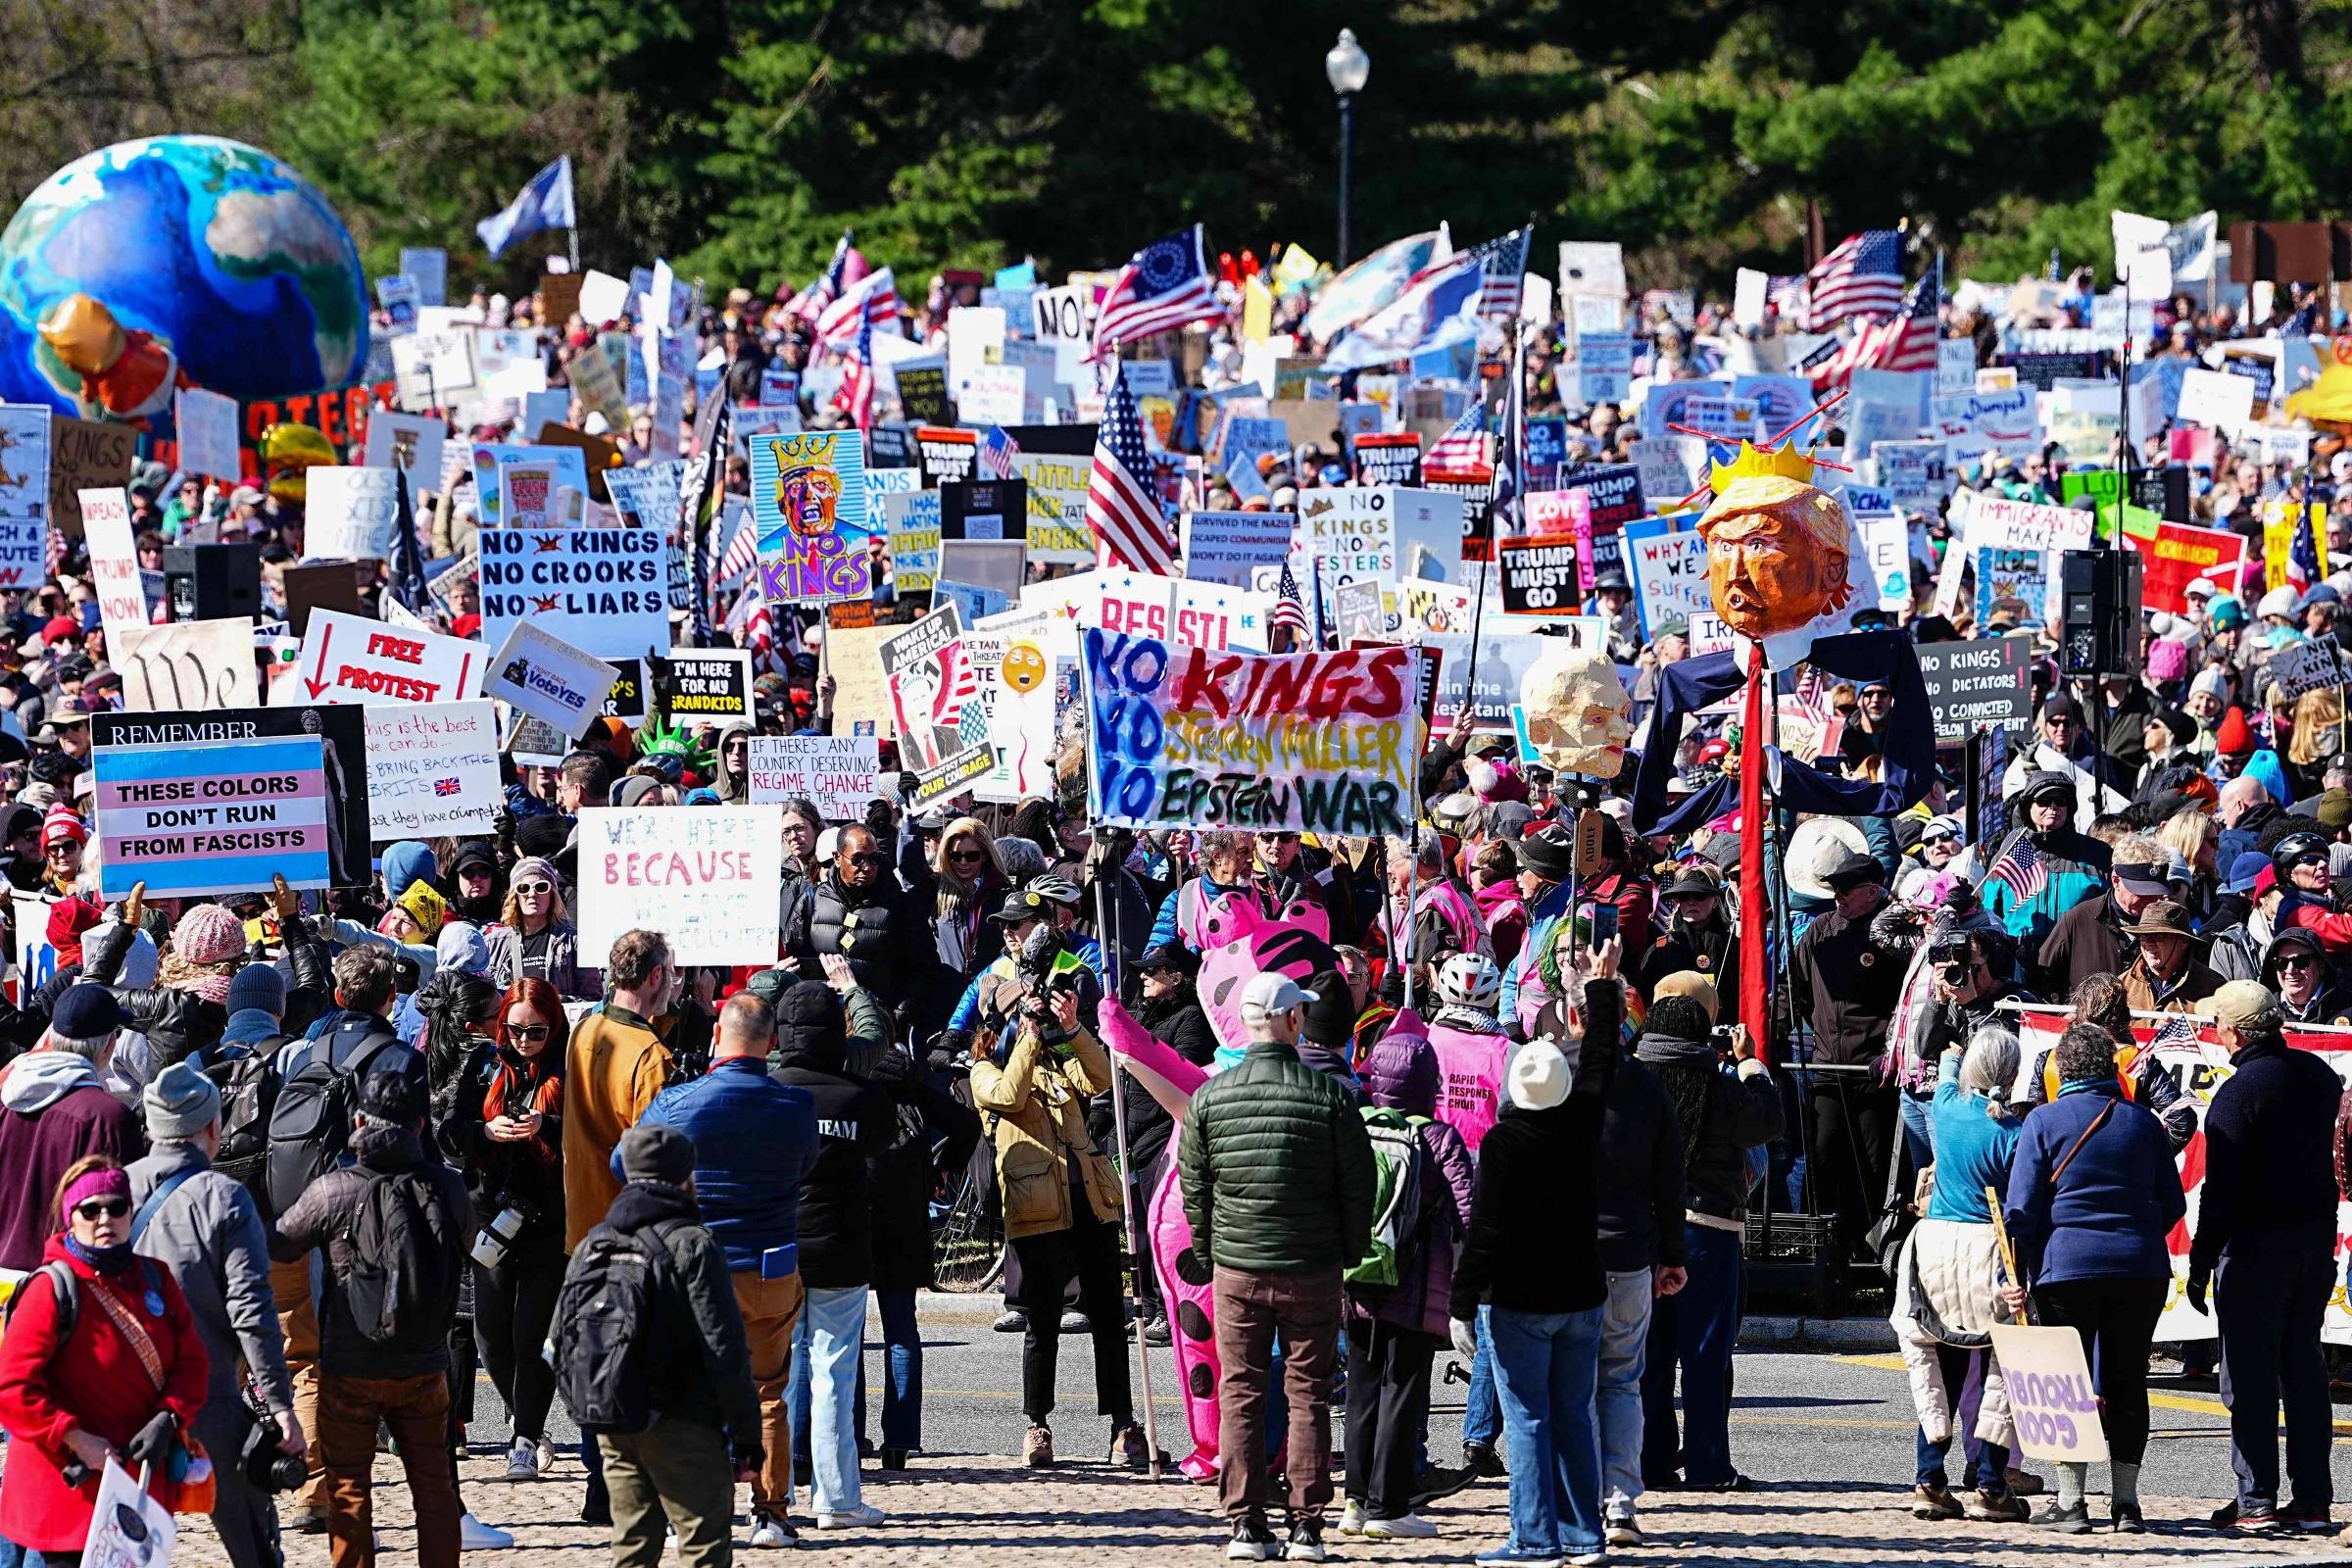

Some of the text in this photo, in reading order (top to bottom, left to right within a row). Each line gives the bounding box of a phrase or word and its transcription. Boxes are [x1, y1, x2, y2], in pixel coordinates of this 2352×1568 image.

[1040, 296, 1079, 339] NO
[58, 424, 125, 469] KINGS
[920, 442, 975, 460] TRUMP
[1357, 447, 1419, 466] TRUMP
[926, 459, 971, 476] MUST
[1588, 476, 1636, 498] RUMP
[1350, 493, 1385, 512] NO
[1463, 503, 1486, 518] ST
[1533, 500, 1585, 520] LOVE
[1603, 494, 1624, 506] THE
[1192, 516, 1291, 528] SURVIVED THE NAZIS
[1593, 506, 1638, 522] ORST
[1979, 502, 2092, 536] IMMIGRANTS
[1313, 518, 1389, 536] KINGS
[2006, 525, 2056, 551] MAKE
[482, 530, 660, 556] NO KINGS
[783, 533, 848, 560] NO
[1336, 536, 1363, 553] NO
[1644, 540, 1685, 561] WHY
[1190, 552, 1224, 562] WON'T
[1226, 552, 1242, 562] DO
[1243, 553, 1251, 562] IT
[1316, 555, 1393, 571] ESTERS
[1501, 546, 1576, 569] TRUMP
[1667, 558, 1696, 576] WE
[92, 559, 135, 580] TRUMP
[484, 562, 524, 586] NO
[531, 560, 658, 585] CROOKS
[760, 550, 870, 601] KINGS
[1510, 566, 1570, 589] MUST
[485, 590, 662, 617] NO LIARS
[1526, 588, 1558, 609] GO
[1648, 579, 1713, 610] SUFFER
[103, 597, 140, 621] NOW
[892, 615, 943, 654] WAKE UP
[367, 633, 427, 665] FREE
[892, 624, 953, 672] AMERICA!
[673, 661, 733, 678] I'M HERE
[1921, 656, 1940, 672] NO
[337, 664, 441, 703] PROTEST
[528, 669, 587, 710] VoteYES
[680, 677, 729, 695] FOR MY
[1175, 647, 1407, 723] KINGS
[1437, 677, 1463, 696] oin
[1472, 678, 1501, 696] the
[1932, 699, 2013, 720] O CONVICTED
[110, 721, 258, 746] REMEMBER
[364, 714, 477, 738] his is the best
[387, 739, 415, 752] can
[514, 735, 546, 745] NYTHING
[531, 742, 554, 752] THEM?
[751, 737, 857, 755] IF THERE'S ANY
[1281, 713, 1408, 790] MILLER
[375, 753, 494, 778] BRING BACK THE
[749, 755, 877, 774] COUNTRY DESERVING
[945, 753, 992, 786] COURAGE
[117, 775, 300, 804] THESE COLORS
[368, 782, 431, 799] BRITS
[752, 772, 874, 795] REGIME CHANGE
[815, 791, 837, 804] THE
[1158, 767, 1289, 823] EPSTEIN
[1295, 772, 1404, 834] WAR
[146, 804, 277, 829] DON'T RUN
[392, 802, 502, 831] they have crumpets
[821, 803, 867, 820] STATE
[120, 829, 306, 858] FROM FASCISTS
[1585, 825, 1596, 863] ADOLF
[604, 850, 753, 886] BECAUSE
[1448, 1073, 1476, 1086] RAPID
[1448, 1085, 1494, 1100] RESPONSE
[1447, 1098, 1476, 1110] CHOIR
[817, 1119, 858, 1142] TEAM
